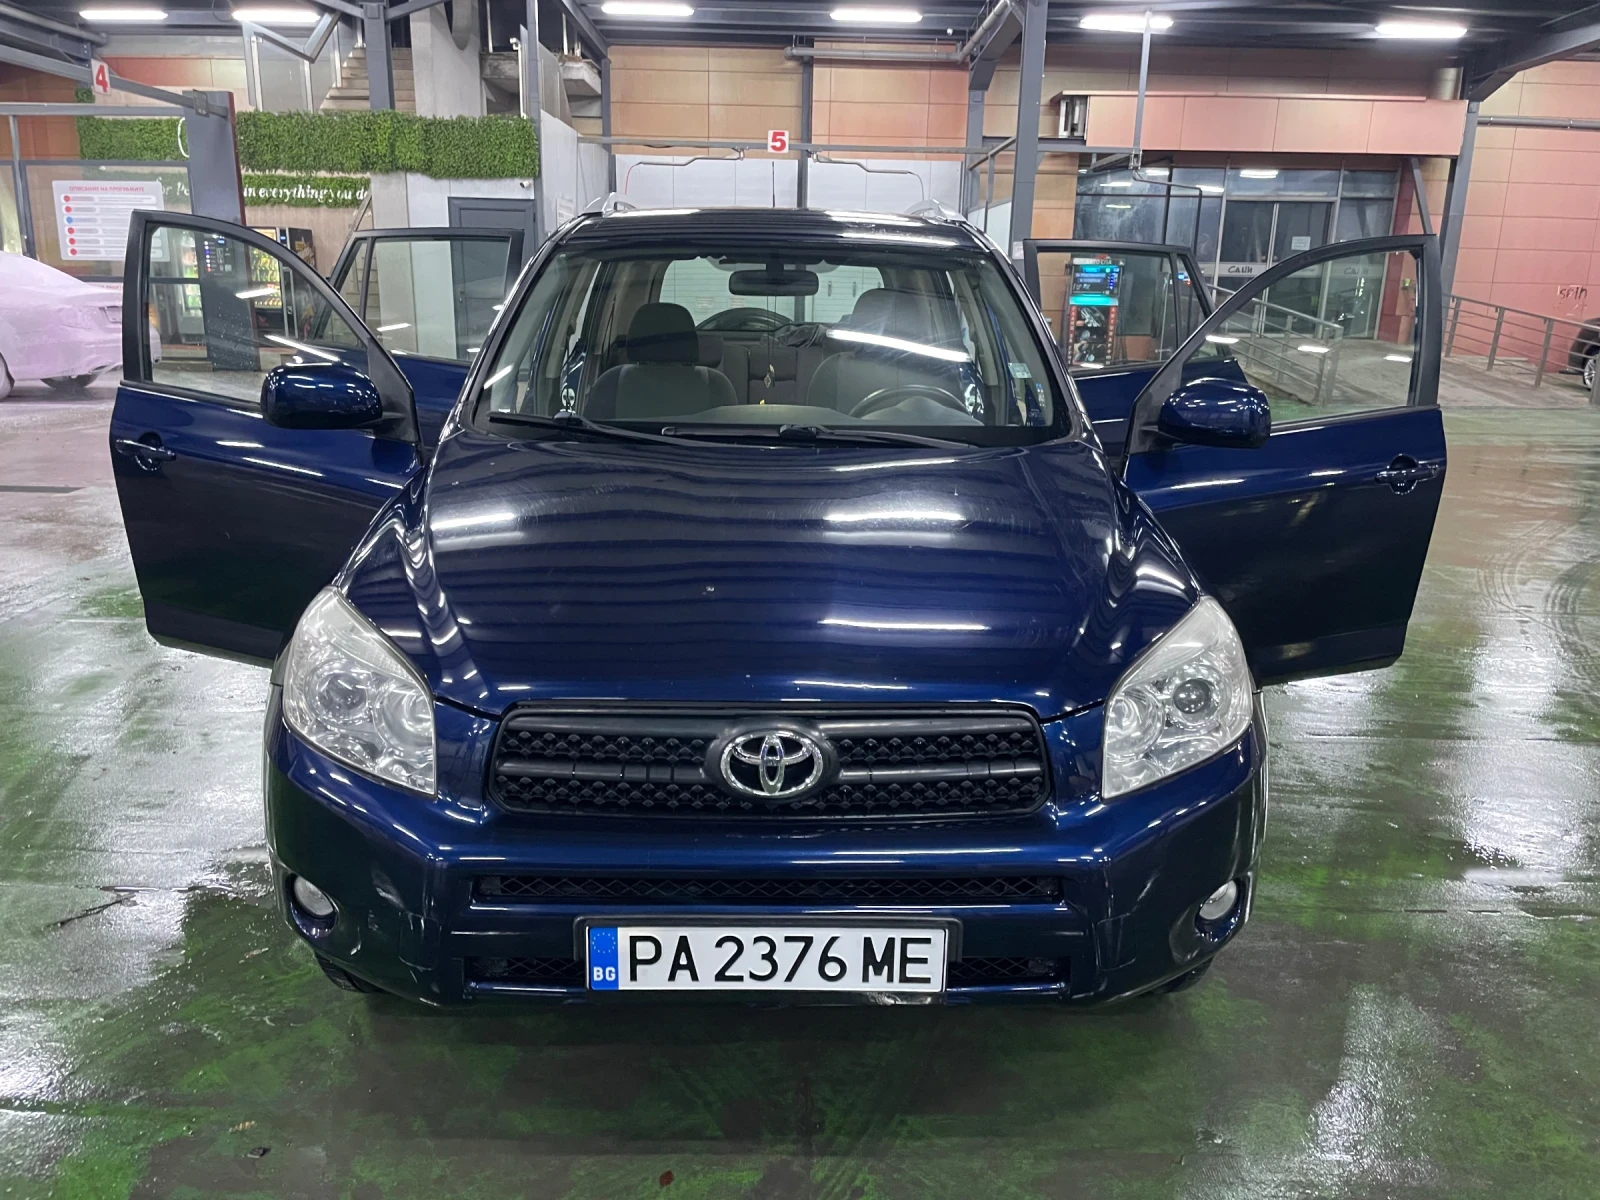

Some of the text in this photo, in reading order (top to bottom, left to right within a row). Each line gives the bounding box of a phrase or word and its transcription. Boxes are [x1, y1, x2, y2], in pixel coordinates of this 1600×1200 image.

[95, 64, 108, 93] 4
[770, 131, 787, 152] 5
[258, 184, 328, 202] everything
[628, 935, 932, 984] PA 2376 ME
[593, 966, 616, 982] BG
